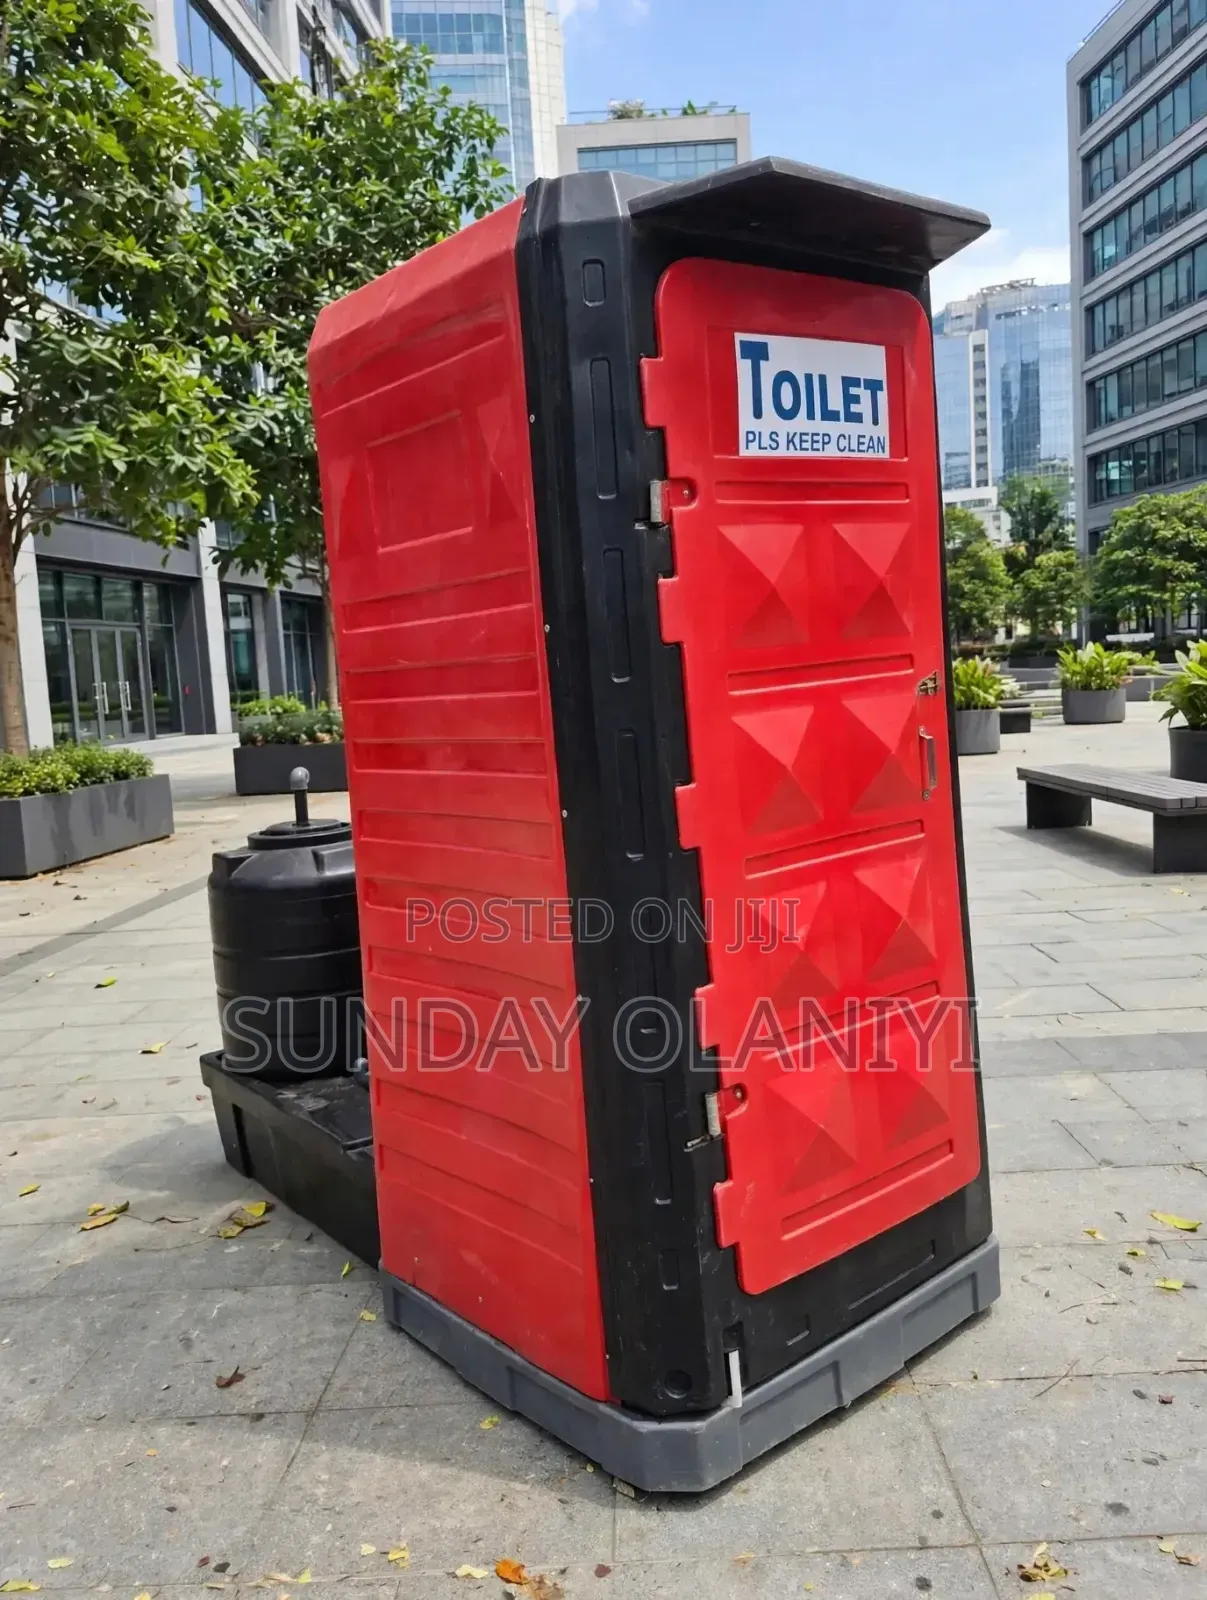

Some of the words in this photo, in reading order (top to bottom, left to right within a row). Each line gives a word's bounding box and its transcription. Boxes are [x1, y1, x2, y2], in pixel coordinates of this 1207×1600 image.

[739, 340, 884, 427] TOILET
[745, 431, 780, 451] PLS
[786, 432, 831, 452] KEEP
[836, 434, 886, 454] CLEAN
